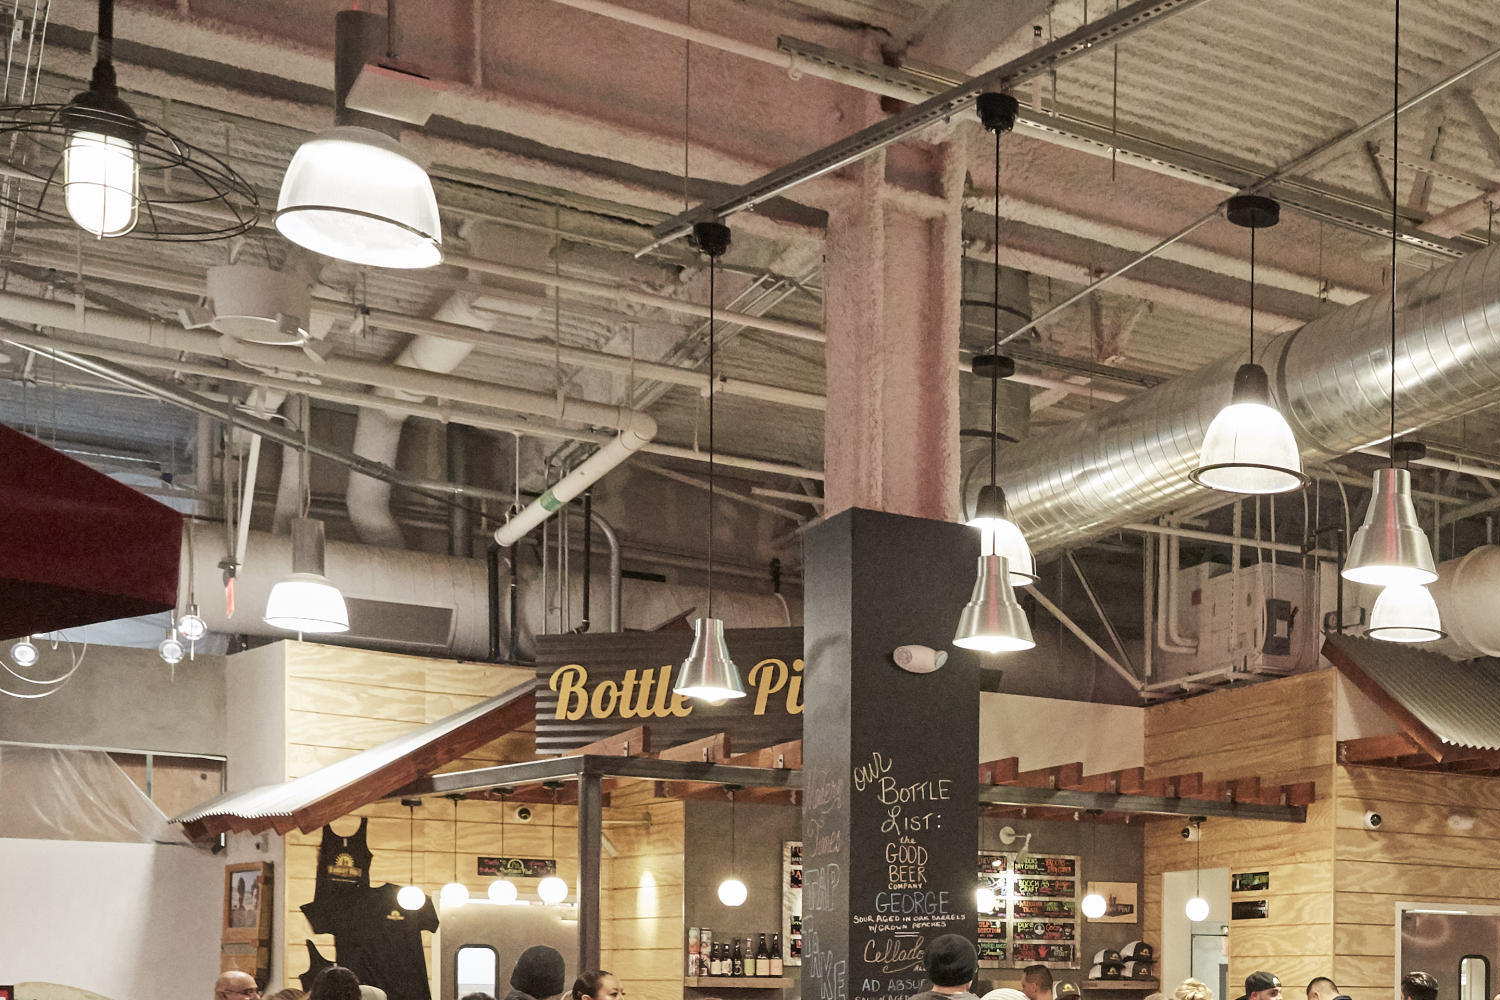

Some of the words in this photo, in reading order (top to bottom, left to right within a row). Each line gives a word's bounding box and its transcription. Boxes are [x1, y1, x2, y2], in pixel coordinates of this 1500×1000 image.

[748, 658, 804, 716] Pi
[877, 776, 952, 805] BOTTLE
[881, 805, 941, 835] LIST:
[899, 835, 916, 844] the
[885, 842, 928, 866] GOOD
[888, 864, 928, 883] BEER
[804, 863, 840, 911] TAP
[888, 882, 923, 890] COMPANY
[875, 891, 949, 914] GEORGE
[853, 915, 874, 924] SOUR
[876, 914, 900, 922] AGED
[863, 935, 925, 963] Cellado
[862, 978, 880, 992] AD
